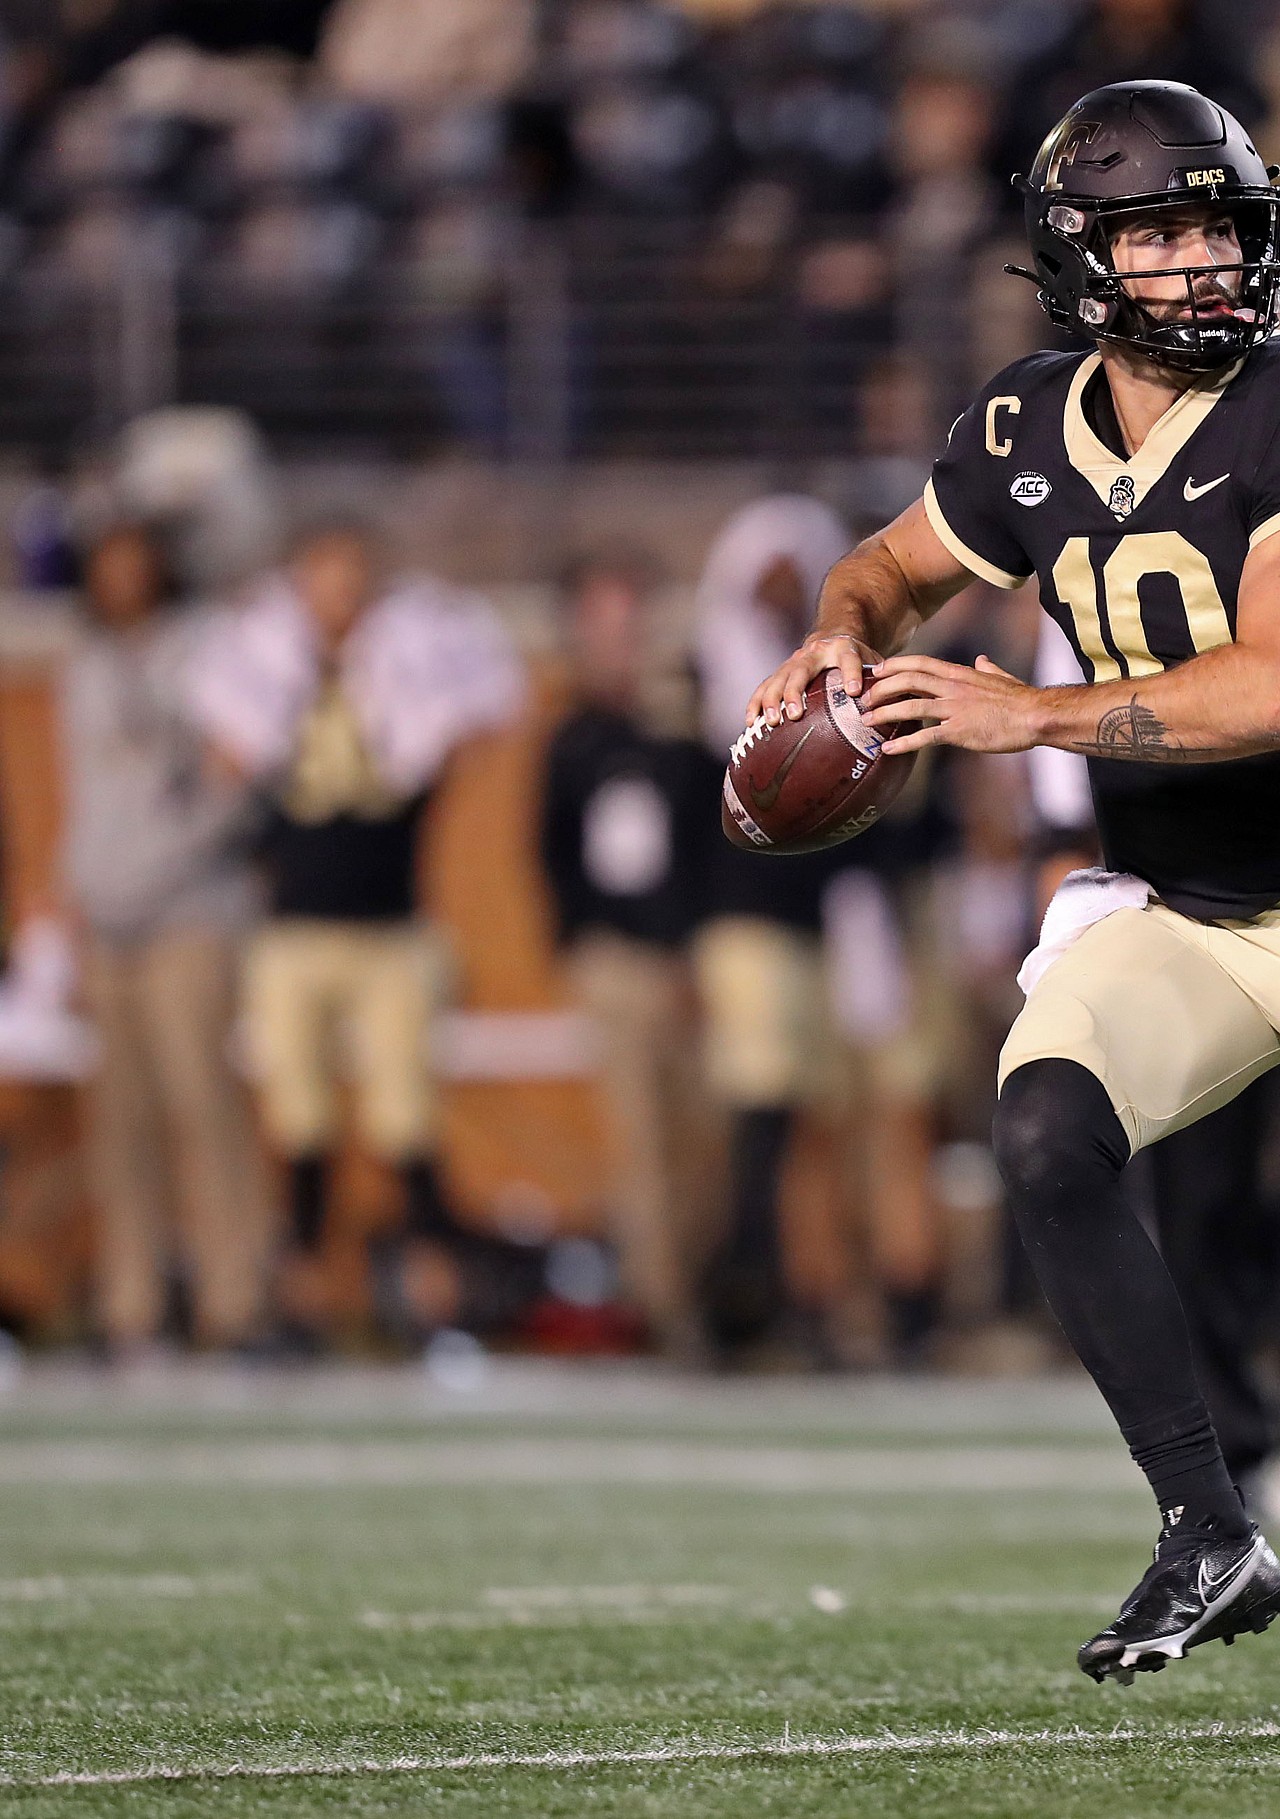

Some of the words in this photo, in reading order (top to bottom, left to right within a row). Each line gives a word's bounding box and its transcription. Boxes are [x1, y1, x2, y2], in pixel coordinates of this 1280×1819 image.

[1185, 168, 1226, 188] DEACS
[1085, 250, 1114, 286] Ridll
[985, 395, 1022, 458] C
[1014, 480, 1045, 495] ACC
[1052, 530, 1235, 686] 10
